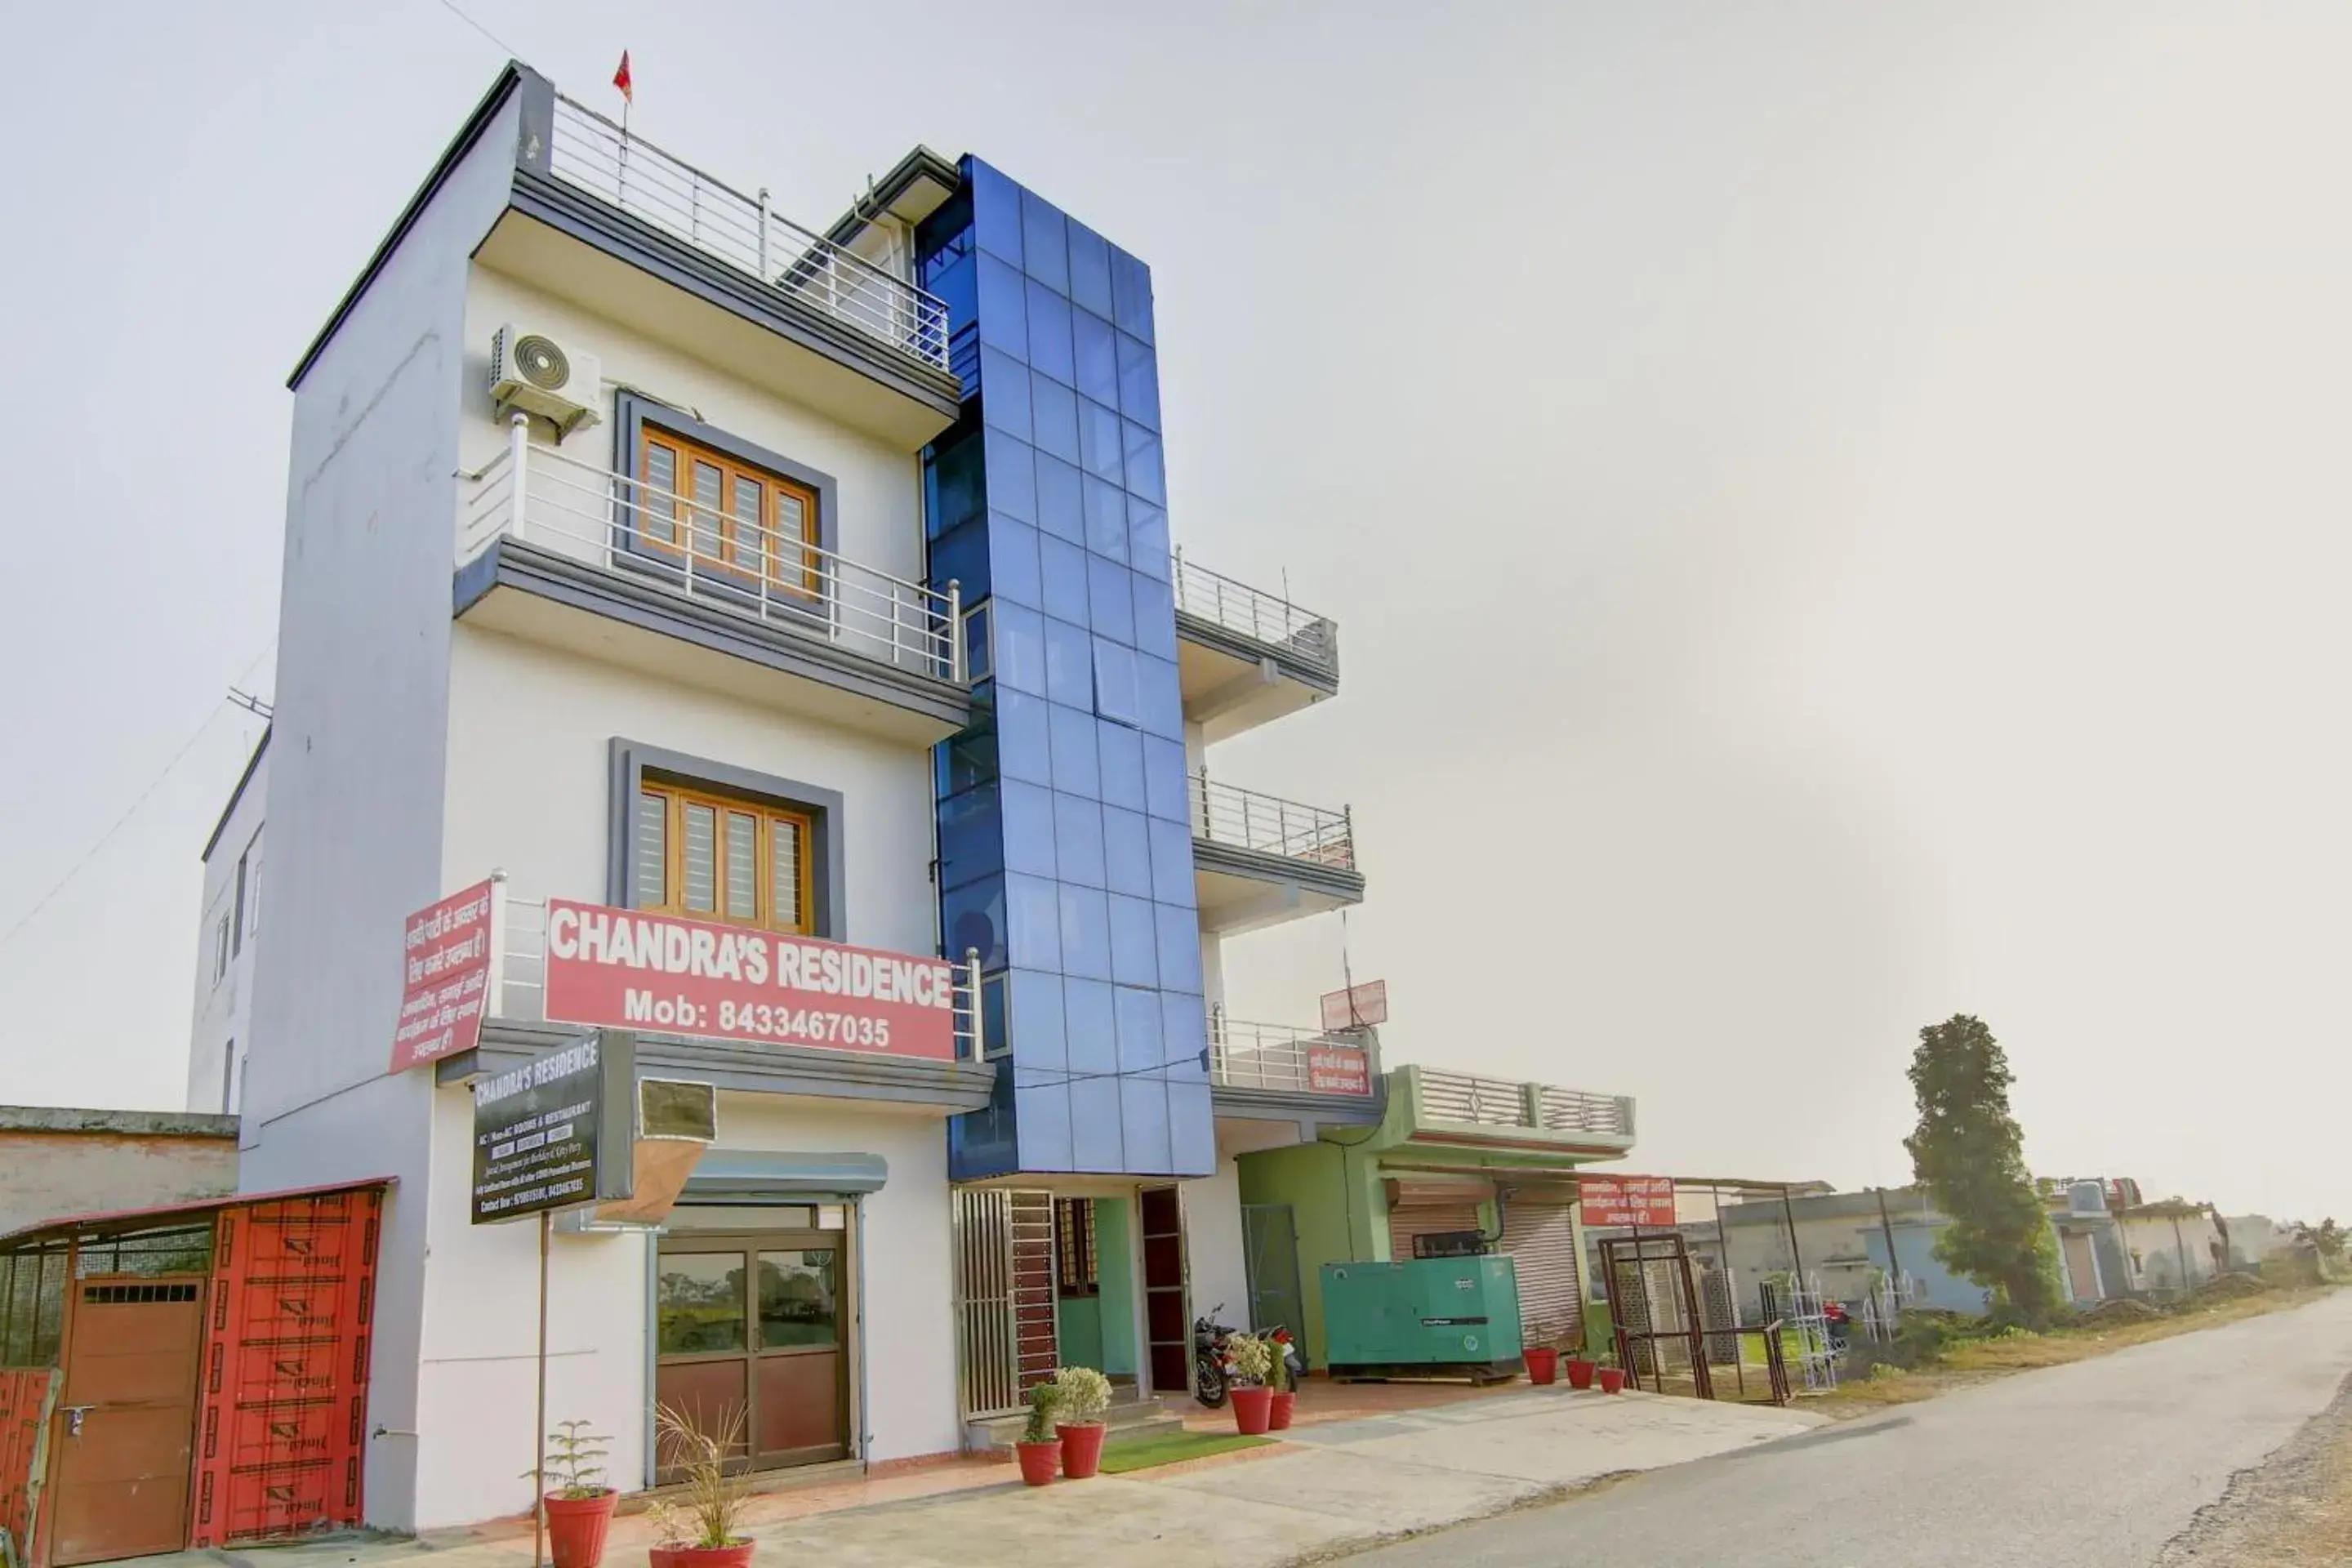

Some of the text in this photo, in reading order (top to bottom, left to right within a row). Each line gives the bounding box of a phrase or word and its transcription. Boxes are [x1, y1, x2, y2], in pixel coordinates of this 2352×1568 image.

[550, 907, 951, 1009] CHANDRA'S RESIDENCE
[625, 988, 889, 1048] Mob: 8433467035
[534, 1040, 597, 1086] RESIDENCE
